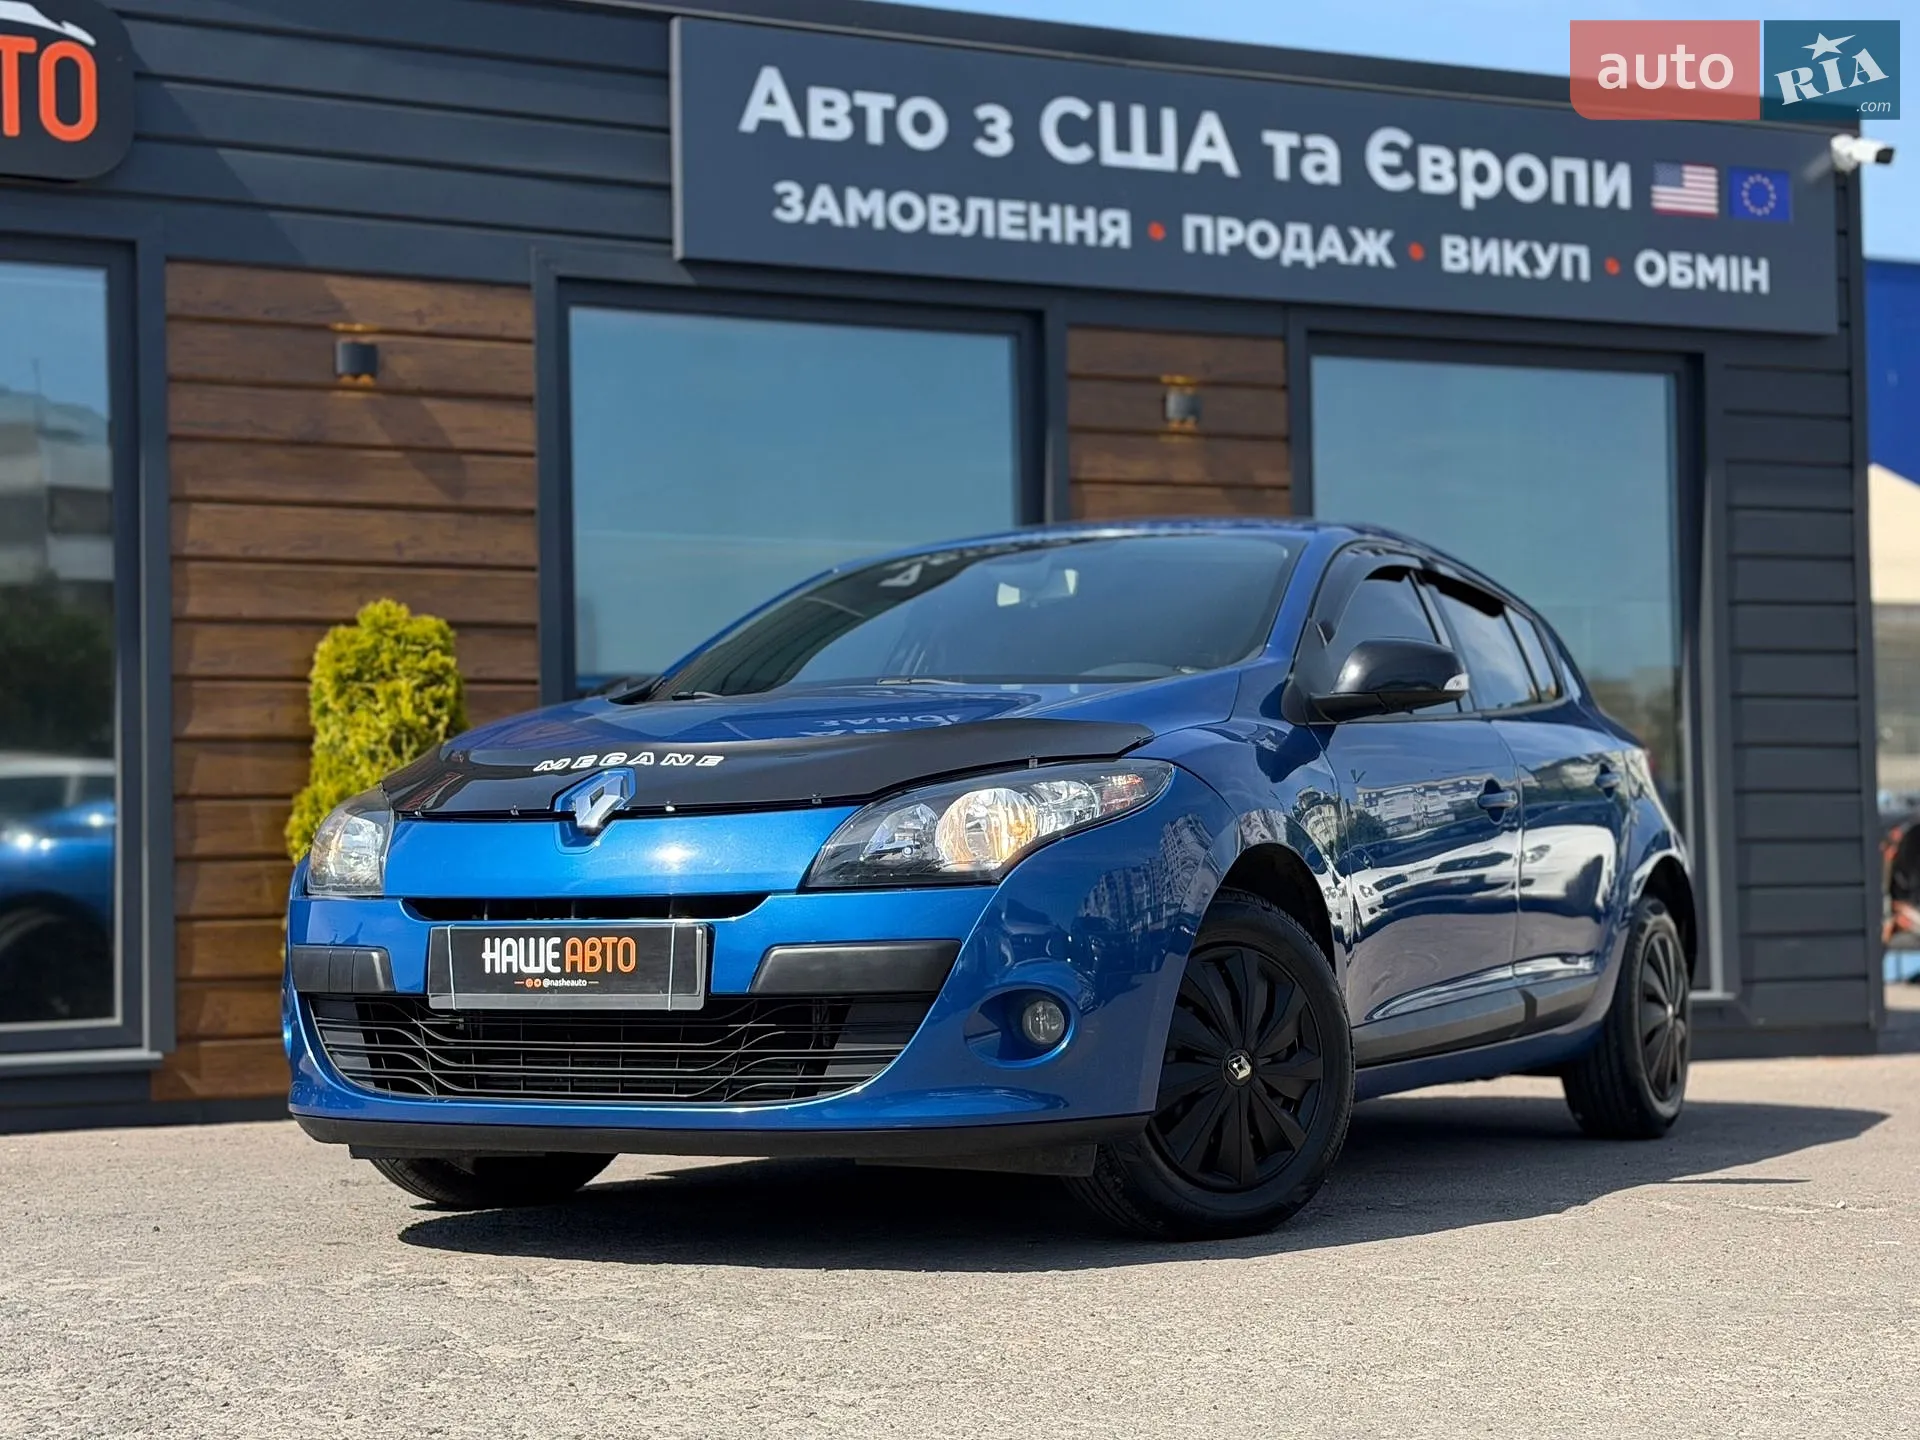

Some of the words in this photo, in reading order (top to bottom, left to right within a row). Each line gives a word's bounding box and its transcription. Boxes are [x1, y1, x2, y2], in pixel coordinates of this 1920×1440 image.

[739, 66, 949, 151] Авто
[974, 104, 1014, 157] з
[1040, 97, 1241, 178] США
[1262, 130, 1342, 186] та
[1365, 127, 1632, 210] Європи
[773, 181, 1131, 249] ЗАМОВЛЕННЯ
[1183, 214, 1396, 268] ПРОДАЖ
[1441, 235, 1591, 282] ВИКУП
[1634, 249, 1770, 295] ОБМІН
[533, 752, 725, 772] MEGANE
[481, 936, 562, 974] НАШЕ
[564, 936, 637, 973] АВТО
[542, 977, 588, 989] @nasheauto
